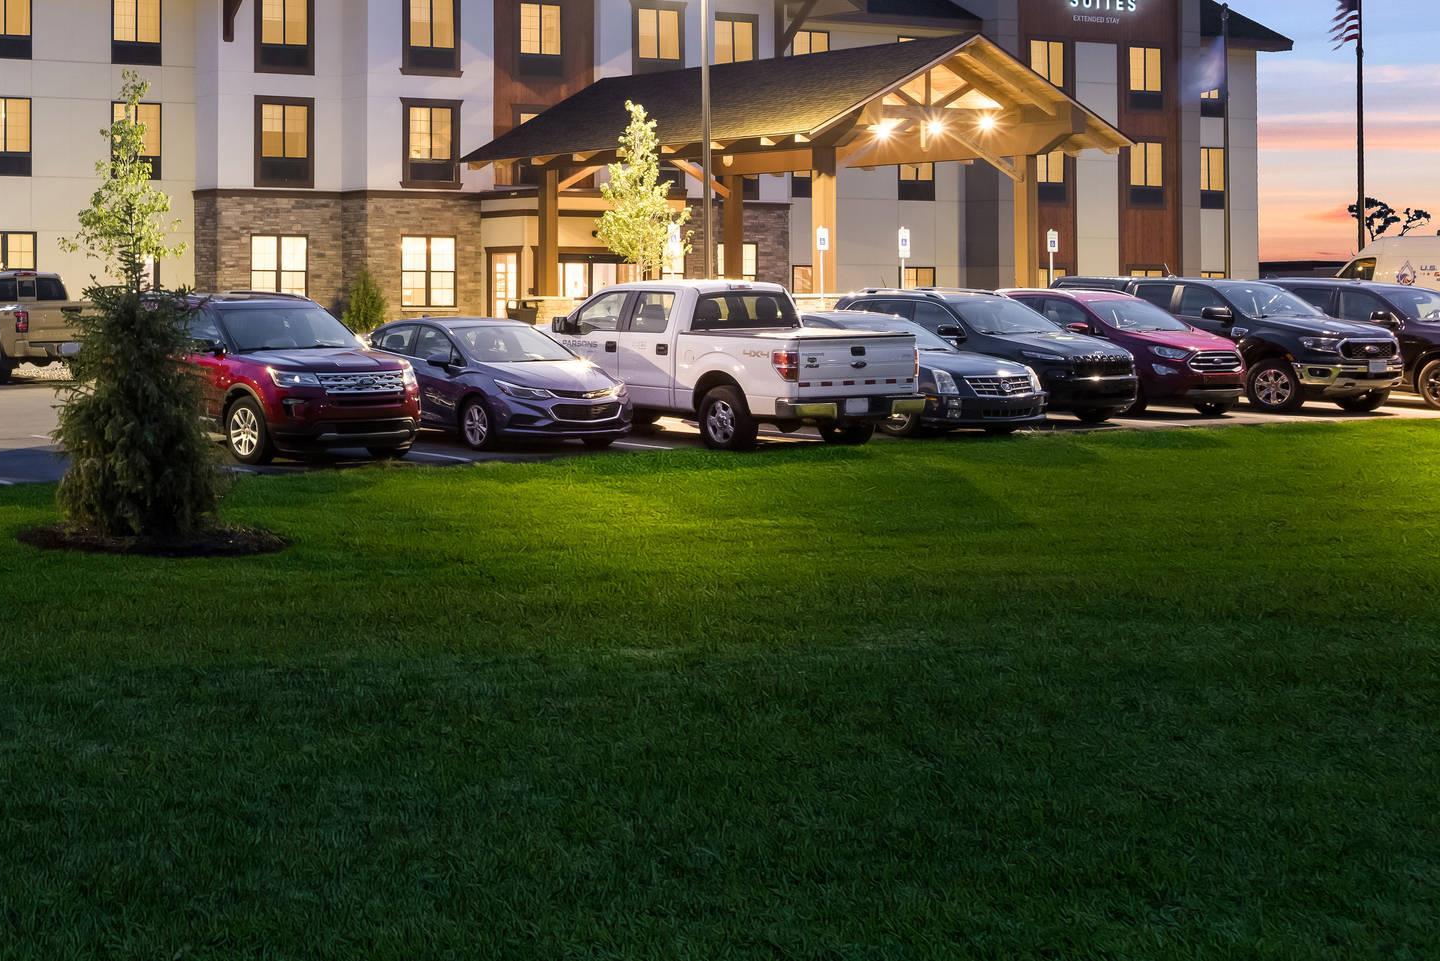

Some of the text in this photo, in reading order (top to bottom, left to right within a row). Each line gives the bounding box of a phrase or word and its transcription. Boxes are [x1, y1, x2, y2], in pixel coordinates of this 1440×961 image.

[1073, 14, 1120, 25] EXTENDED STAY
[562, 339, 599, 348] PARSONS
